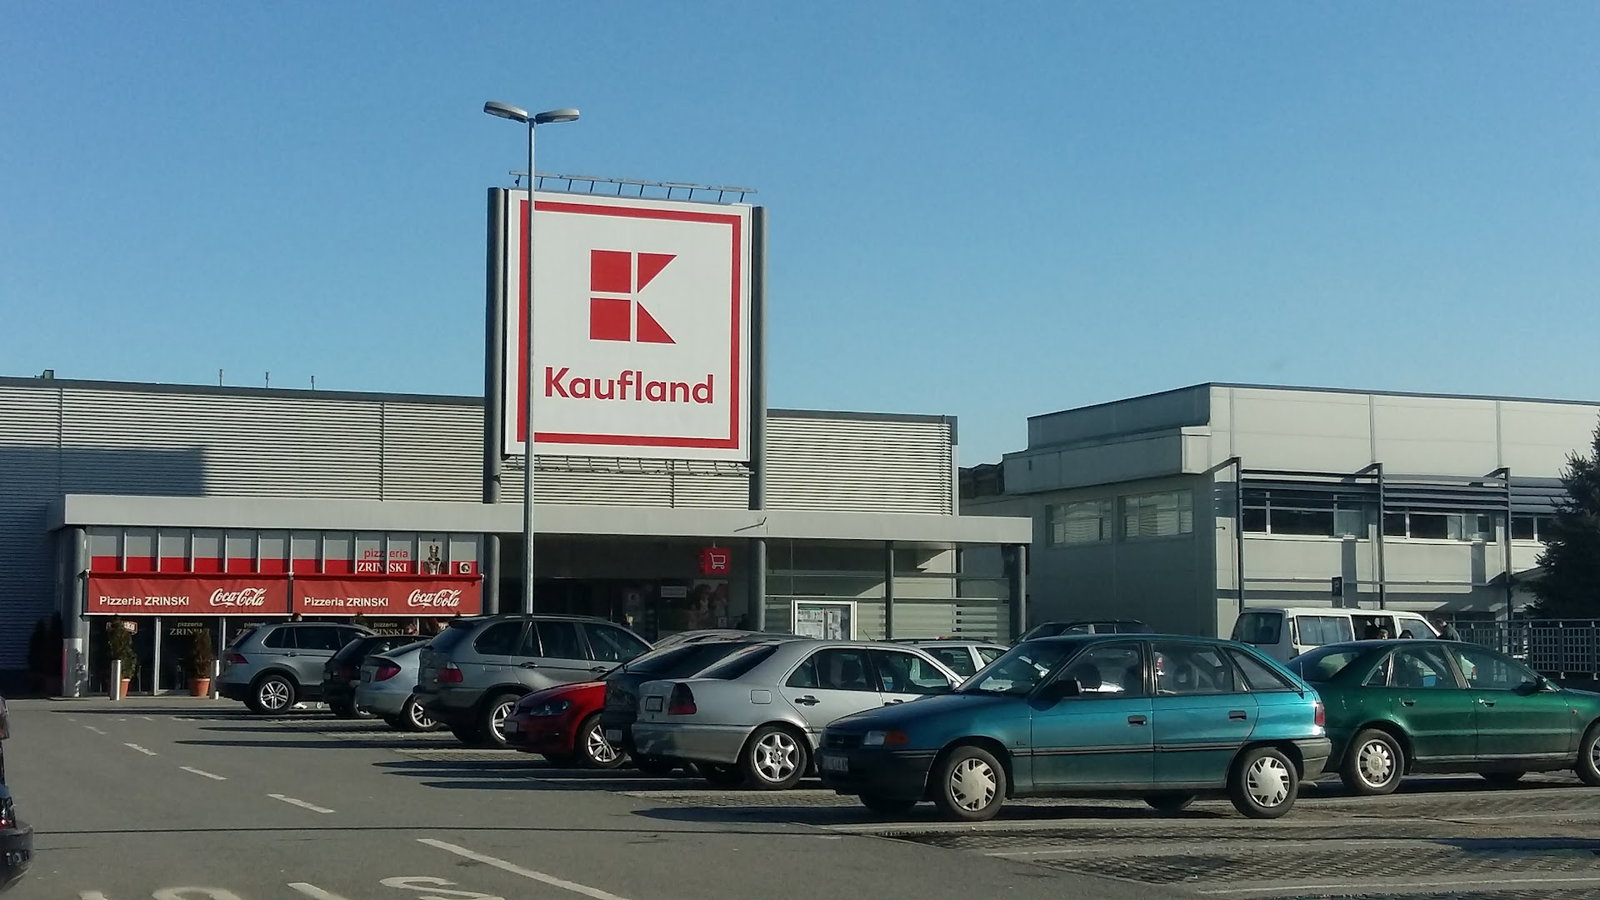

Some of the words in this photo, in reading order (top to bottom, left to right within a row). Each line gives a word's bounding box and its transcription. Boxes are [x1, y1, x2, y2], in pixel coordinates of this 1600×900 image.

[545, 366, 713, 404] Kaufland
[364, 549, 408, 560] pizzeria
[358, 562, 407, 573] ZRINSKI
[99, 596, 141, 606] Pizzeria
[144, 596, 189, 606] ZRINSKI
[304, 597, 344, 607] Pizzeria
[346, 598, 388, 607] ZRINSKI
